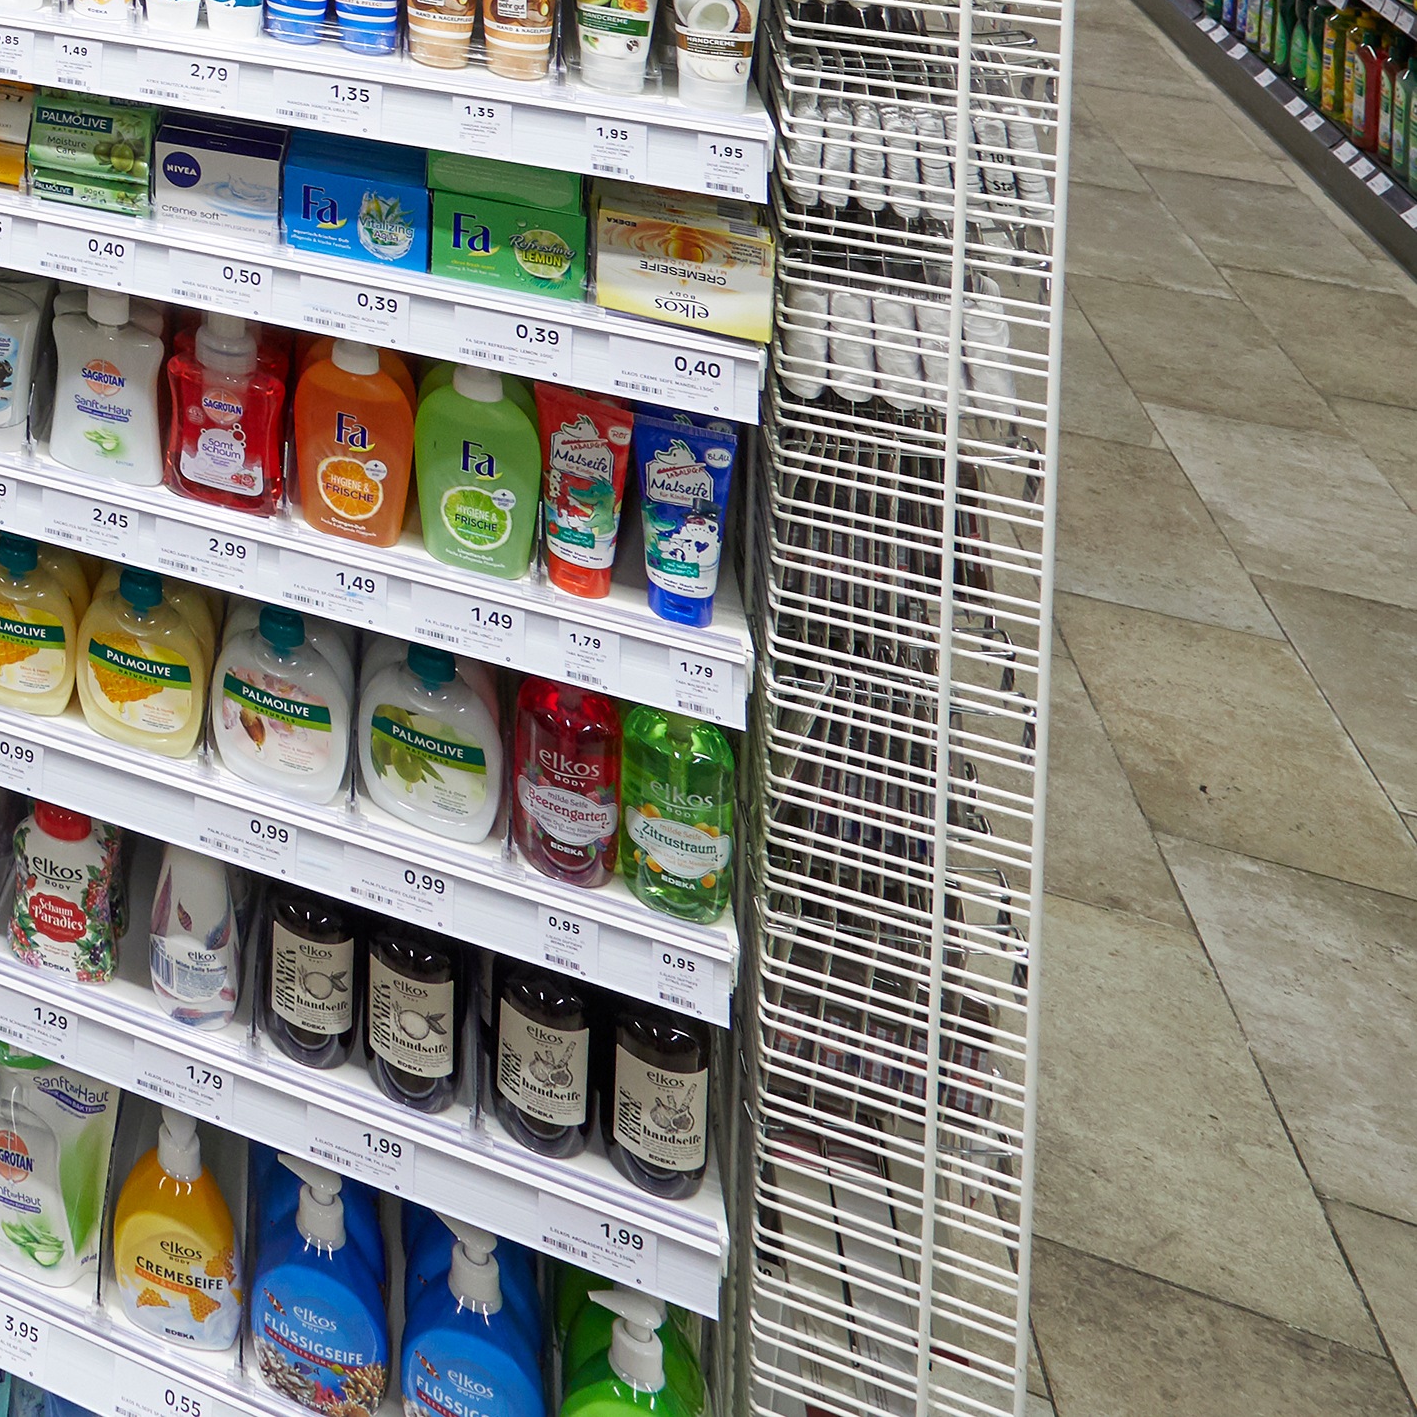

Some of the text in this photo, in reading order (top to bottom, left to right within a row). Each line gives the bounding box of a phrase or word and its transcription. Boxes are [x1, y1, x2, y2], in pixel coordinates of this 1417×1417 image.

[686, 35, 736, 48] HANDCREME
[330, 83, 371, 103] 1,35
[41, 110, 108, 130] PALMOLIVE
[167, 163, 197, 177] NIVEA
[522, 250, 562, 268] LEMON
[515, 323, 560, 345] 0,39
[81, 370, 126, 388] SAGROTAN
[650, 478, 709, 498] Malseife
[93, 508, 129, 529] 2,45
[454, 513, 497, 533] FRISCHE
[241, 685, 310, 717] PALMOLIVE
[539, 748, 600, 779] elkos
[528, 787, 608, 822] Beerengarten
[642, 821, 717, 854] Zitrustraum
[550, 841, 584, 857] EDEKA
[404, 869, 446, 894] 0,99
[38, 897, 74, 918] Schaum
[33, 905, 85, 933] Paradies
[186, 1065, 222, 1090] 1,79
[521, 1079, 581, 1102] handseife
[642, 1126, 702, 1146] handseife
[600, 1222, 644, 1251] 1,99
[135, 1255, 224, 1291] CREMESEIFE
[4, 1314, 39, 1343] 3,95
[264, 1311, 364, 1366] FLÜSSIGSEIFE
